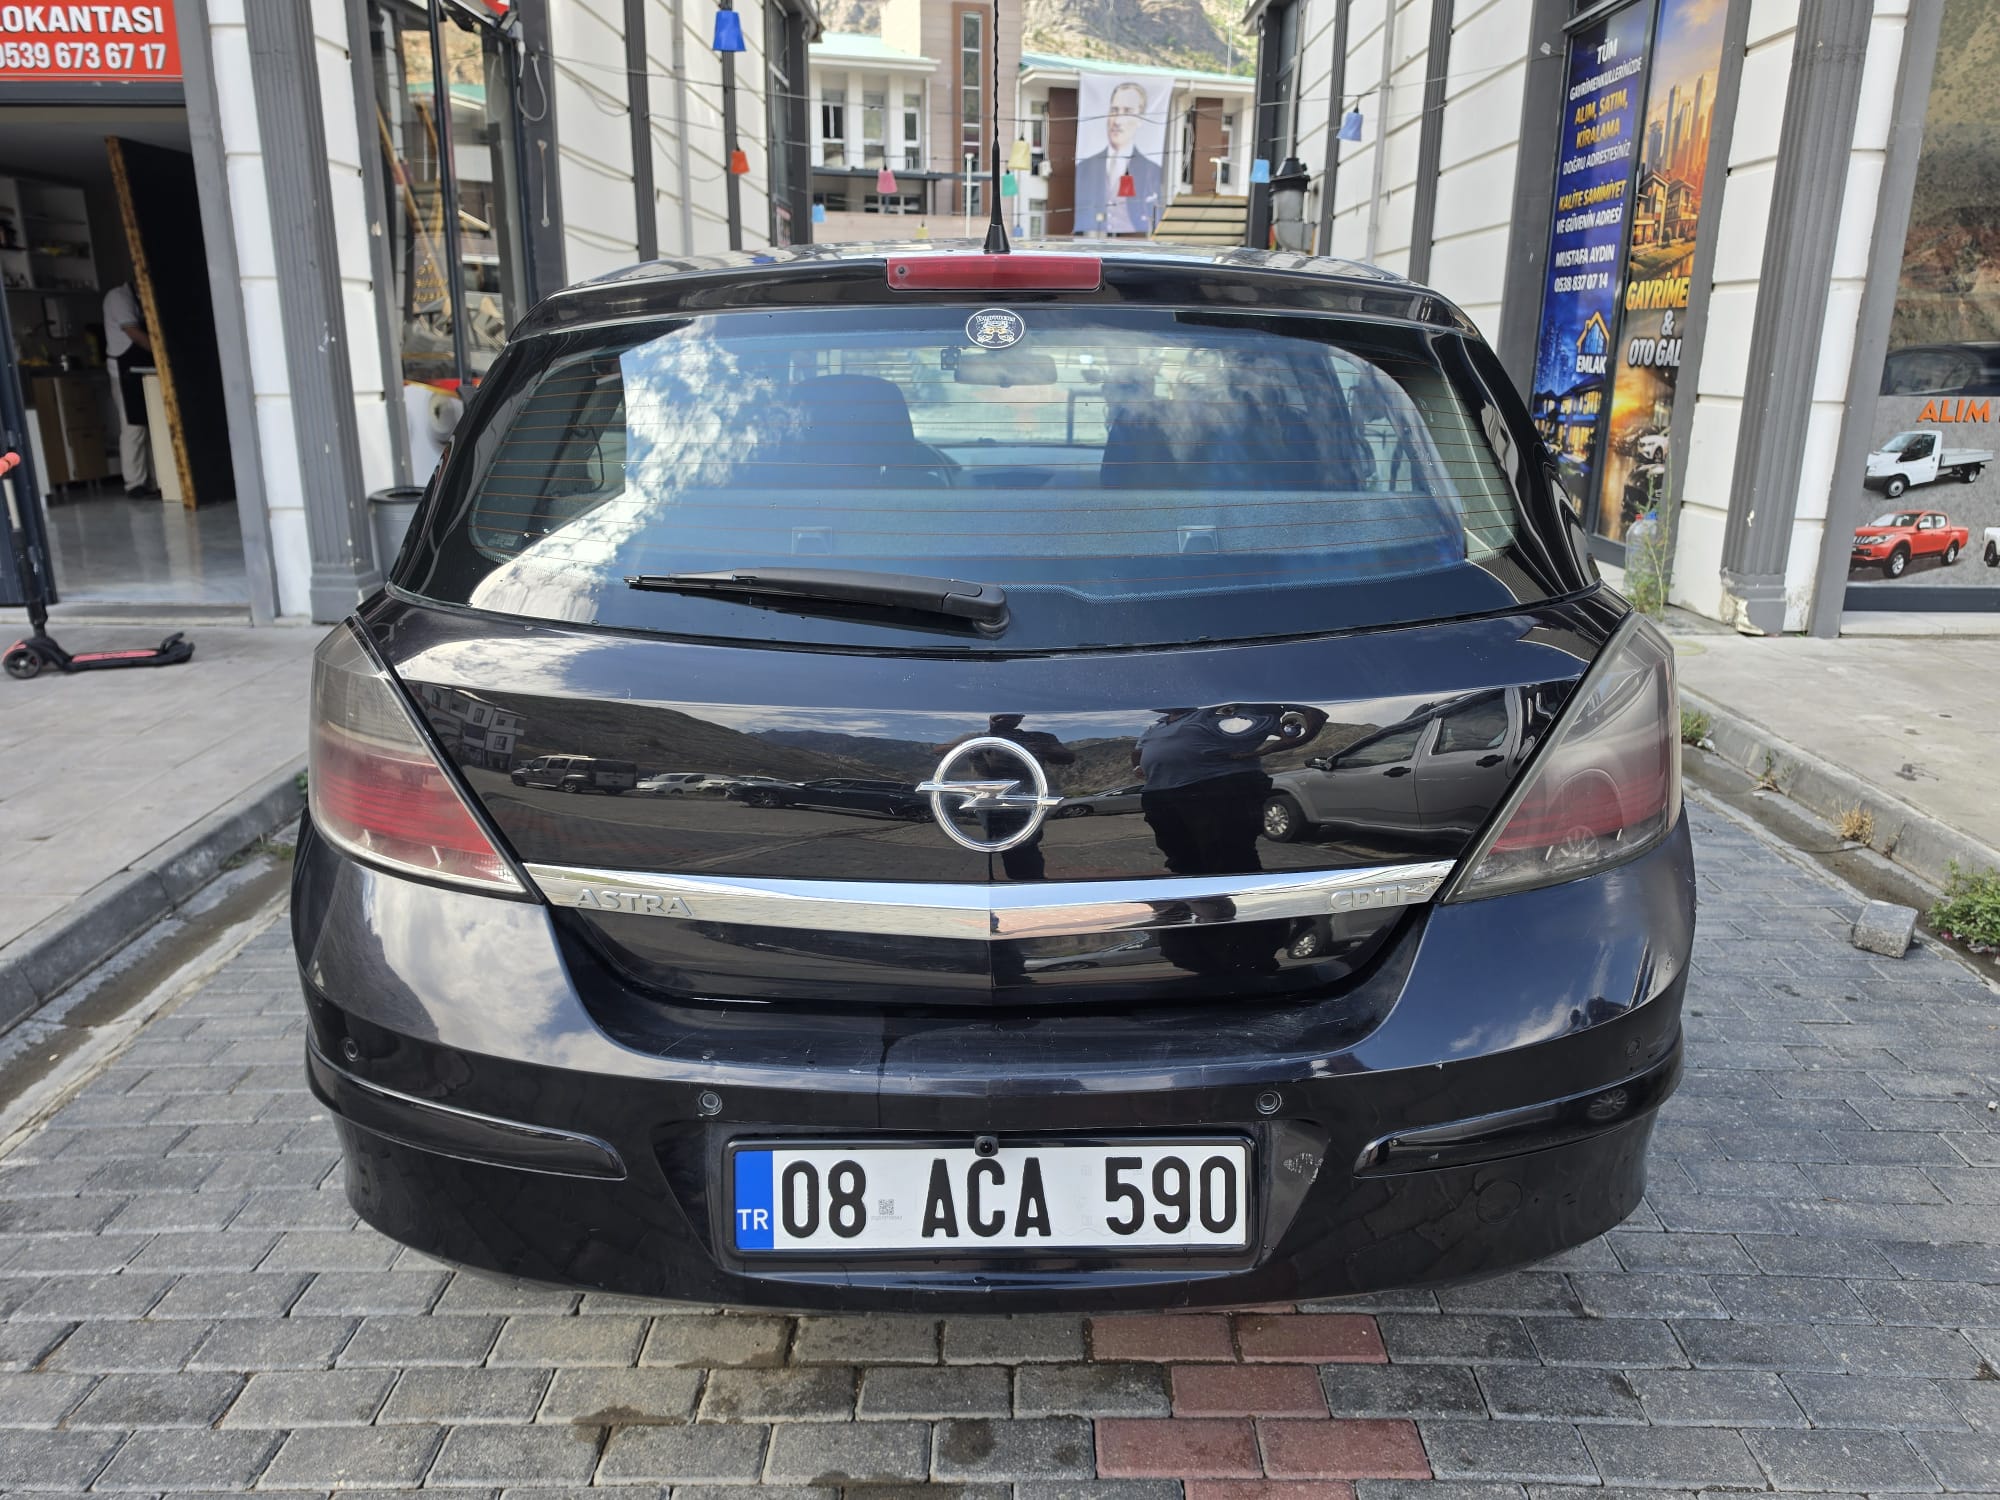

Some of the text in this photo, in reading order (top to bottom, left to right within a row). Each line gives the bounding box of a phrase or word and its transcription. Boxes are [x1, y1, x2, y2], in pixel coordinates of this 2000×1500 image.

[0, 5, 164, 33] OKANTASI
[54, 42, 101, 69] 673
[104, 42, 135, 69] 67
[140, 43, 166, 70] 17
[1597, 37, 1618, 65] TÜM
[1599, 88, 1628, 116] SATIM,
[1576, 117, 1620, 149] KİRALAMA
[1555, 244, 1616, 268] MUSTAFA AYDIN
[1586, 273, 1598, 290] 07
[1661, 310, 1675, 336] &
[1576, 355, 1607, 374] EMLAK
[1628, 338, 1656, 367] OTO
[1916, 399, 1991, 423] ALIM
[575, 888, 694, 917] ASTRA
[1330, 884, 1407, 912] CDTI
[736, 1156, 1237, 1238] TR 08 ACA 590
